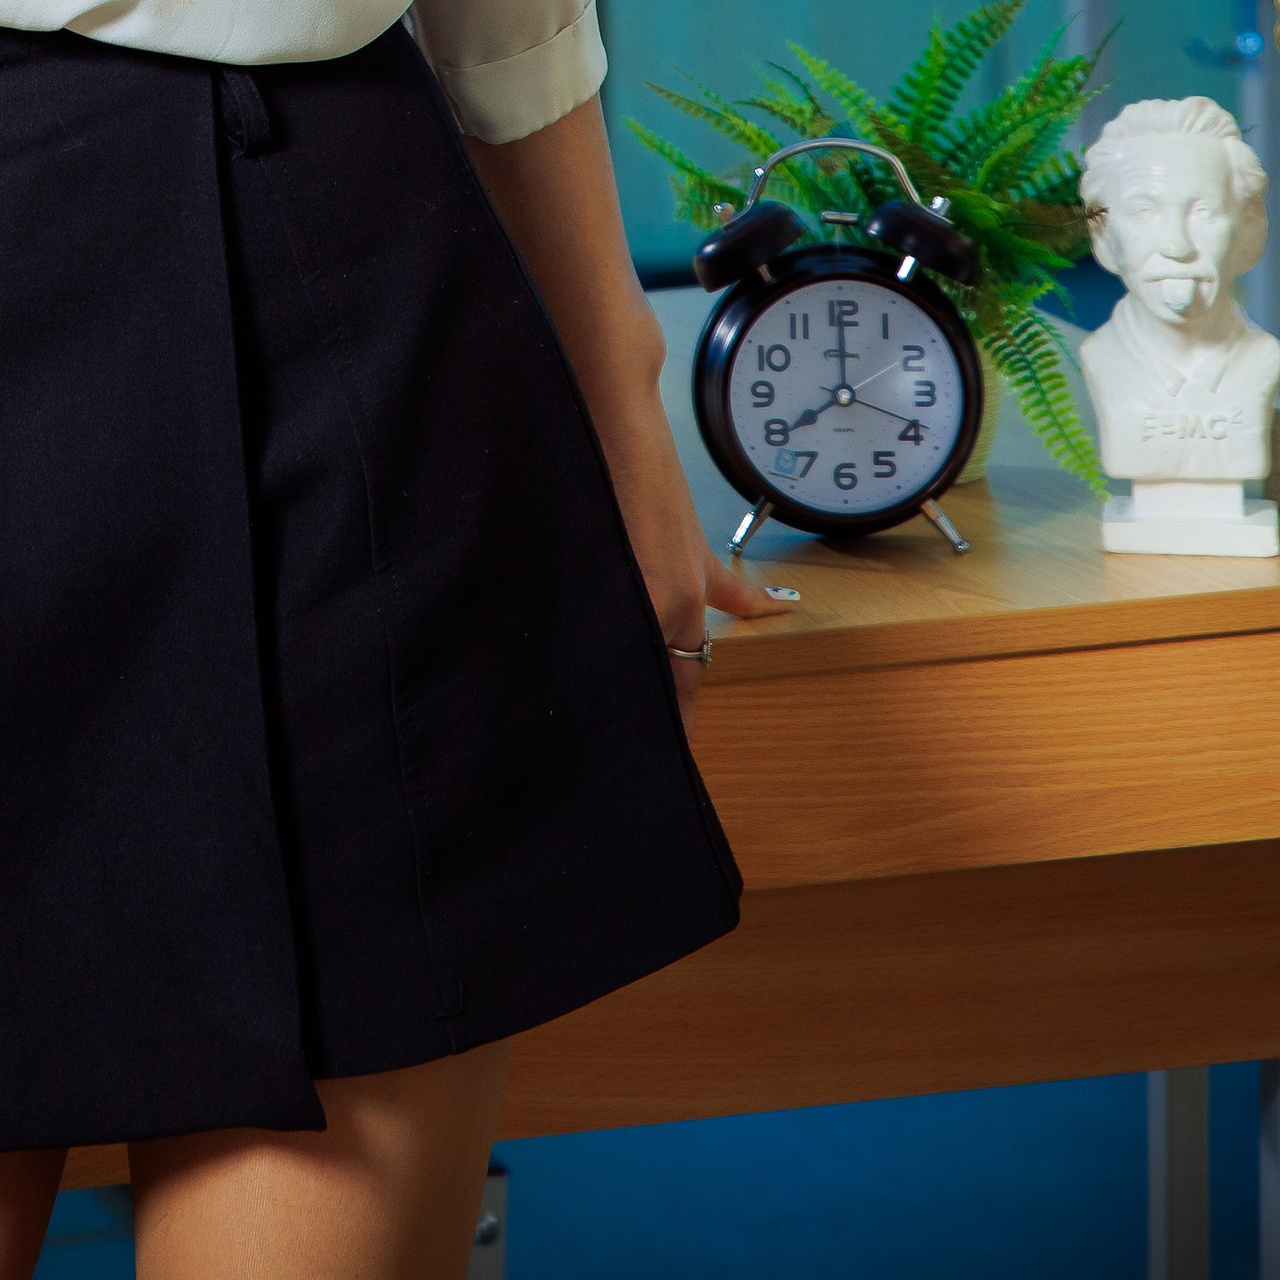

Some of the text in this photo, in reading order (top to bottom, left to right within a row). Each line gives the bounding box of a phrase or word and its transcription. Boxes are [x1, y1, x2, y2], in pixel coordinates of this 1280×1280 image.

[788, 312, 810, 340] 11
[828, 299, 860, 328] 12
[881, 312, 890, 340] 1
[757, 344, 792, 372] 10
[902, 344, 926, 372] 2
[750, 380, 775, 409] 9
[914, 380, 937, 408] 3
[763, 418, 791, 447] 8
[897, 419, 925, 446] 4
[833, 462, 858, 491] 6
[873, 450, 897, 479] 5
